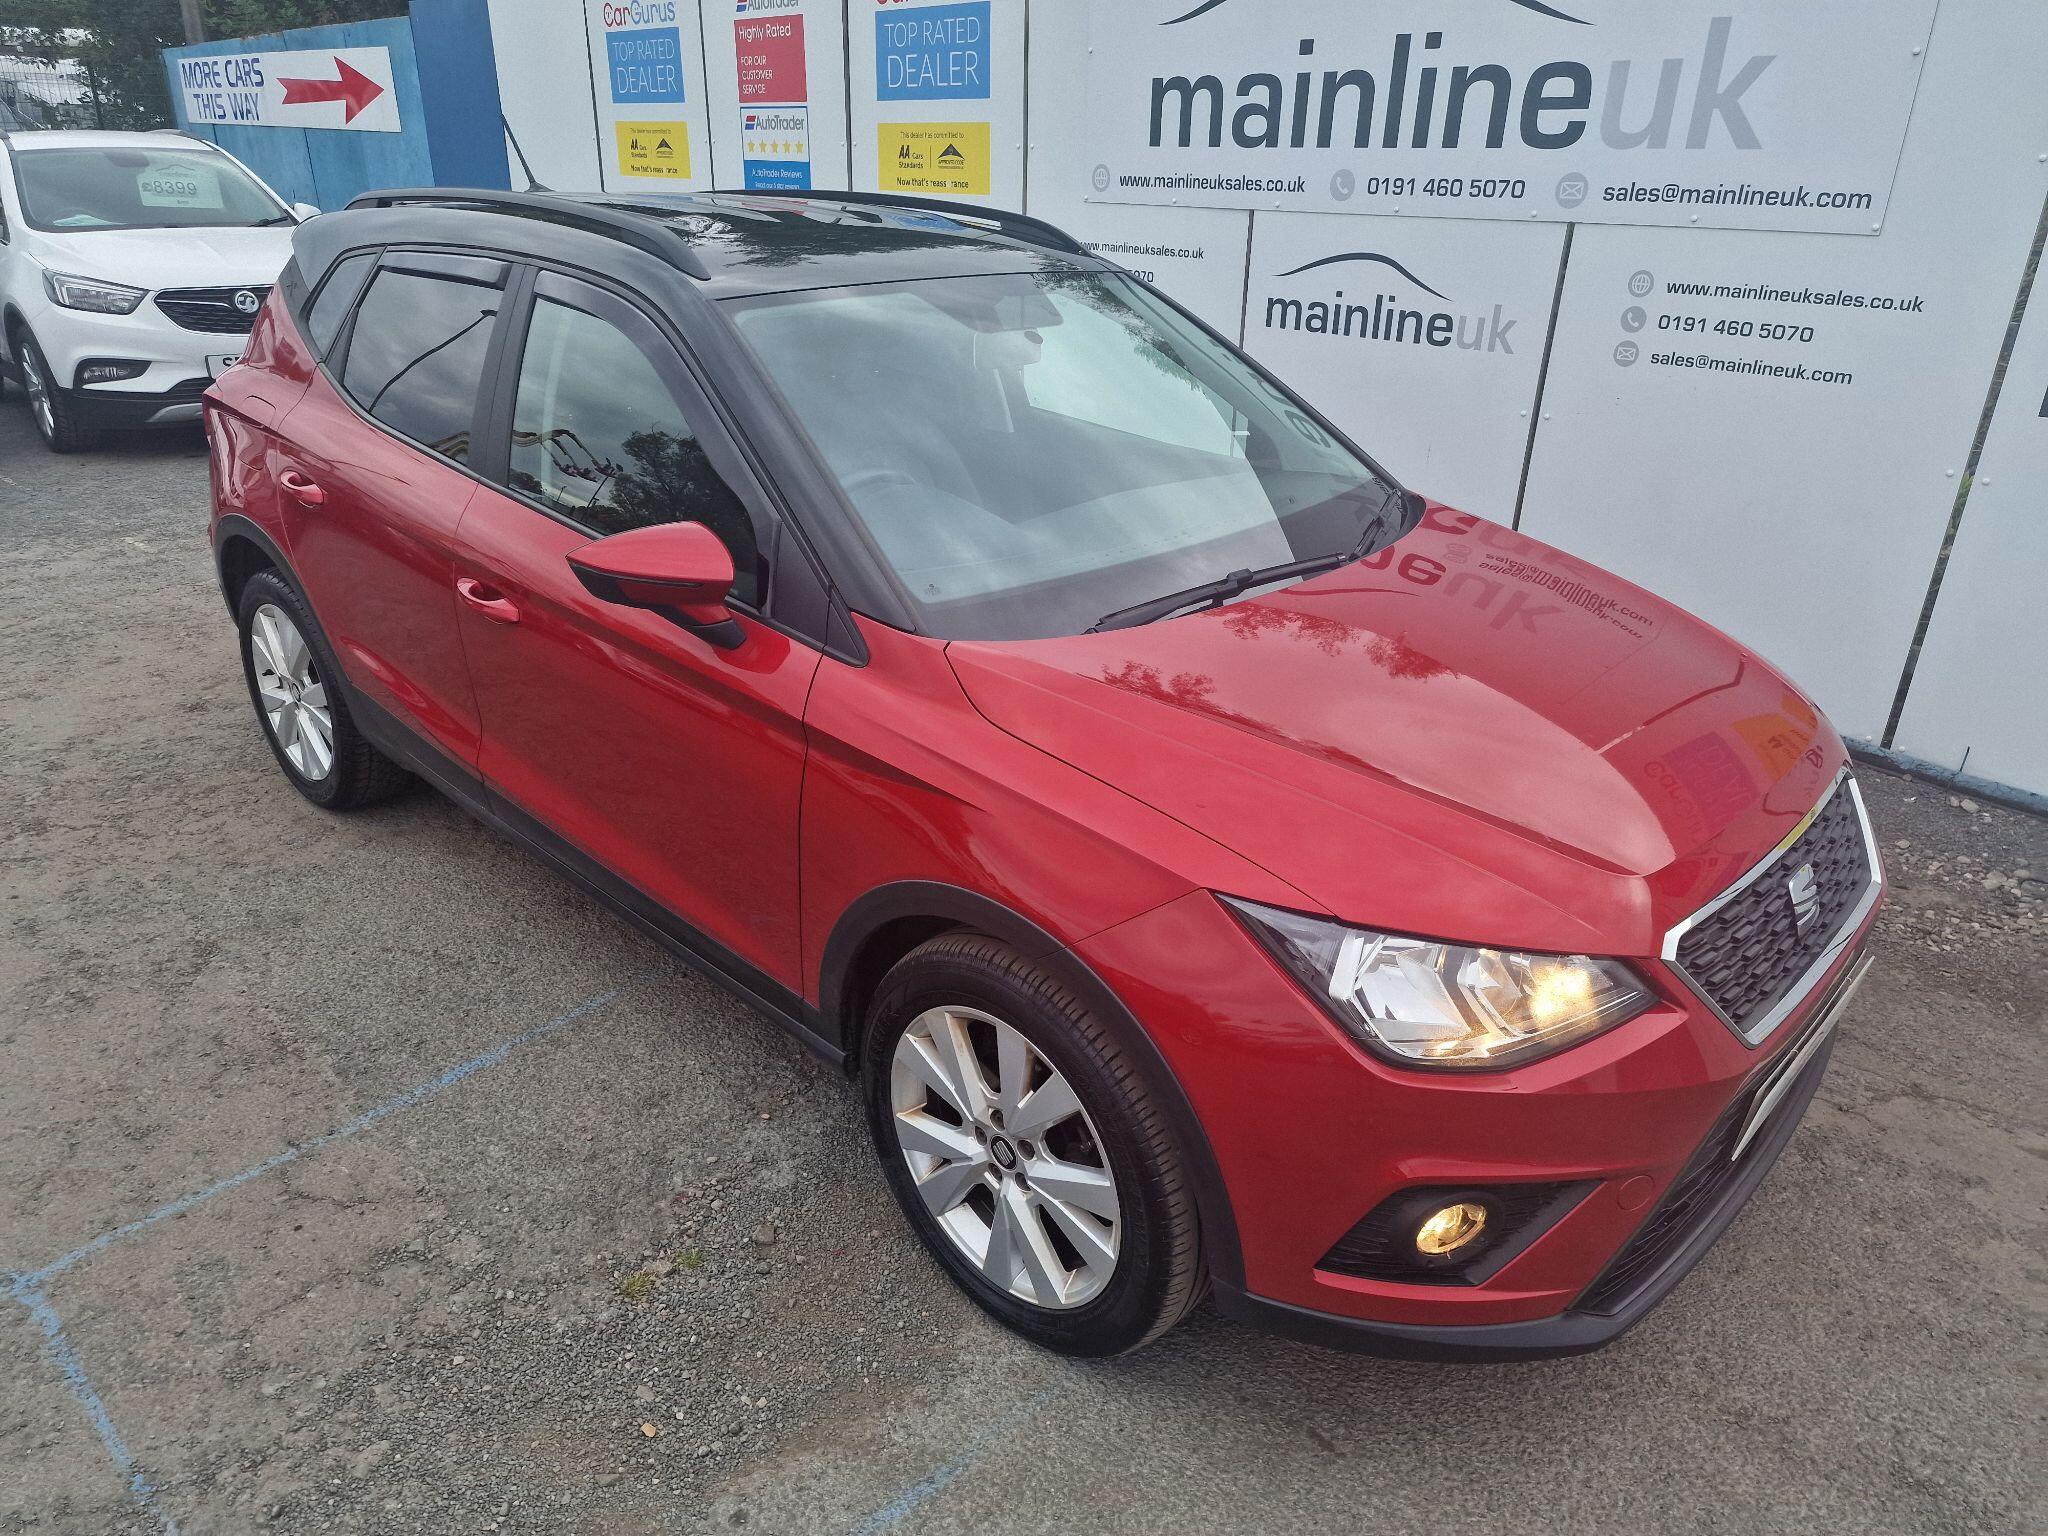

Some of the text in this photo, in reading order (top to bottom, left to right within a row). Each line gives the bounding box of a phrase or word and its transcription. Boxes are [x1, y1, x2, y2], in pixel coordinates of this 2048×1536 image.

[604, 0, 675, 27] CarGurus
[739, 22, 791, 42] Highly Rated
[884, 17, 980, 47] TOP RATED
[612, 38, 675, 61] TOP RATED
[741, 55, 767, 66] FOR OUR
[181, 57, 265, 88] MORE CARS
[617, 65, 678, 93] DEALER
[742, 69, 773, 80] CUSTOMER
[888, 51, 979, 87] DEALER
[742, 84, 766, 94] SERVICE
[1149, 16, 1777, 150] mainlineuk
[192, 92, 260, 121] THIS WAY
[756, 114, 804, 131] AutoTrader
[898, 144, 924, 160] AA Cars
[898, 161, 924, 169] Standards
[896, 177, 911, 187] Now
[911, 178, 929, 188] that's
[1119, 173, 1305, 193] www.mainlineuksales.co.uk
[1367, 177, 1527, 199] 0191 460 5070
[1602, 181, 1872, 209] sales@mainlineuk.com
[1666, 281, 1925, 313] www.mainlineuksales.co.uk
[1265, 290, 1517, 354] mainlineuk
[1657, 314, 1814, 343] 0191 460 5070
[1650, 351, 1853, 385] sales@mainlineuk.com
